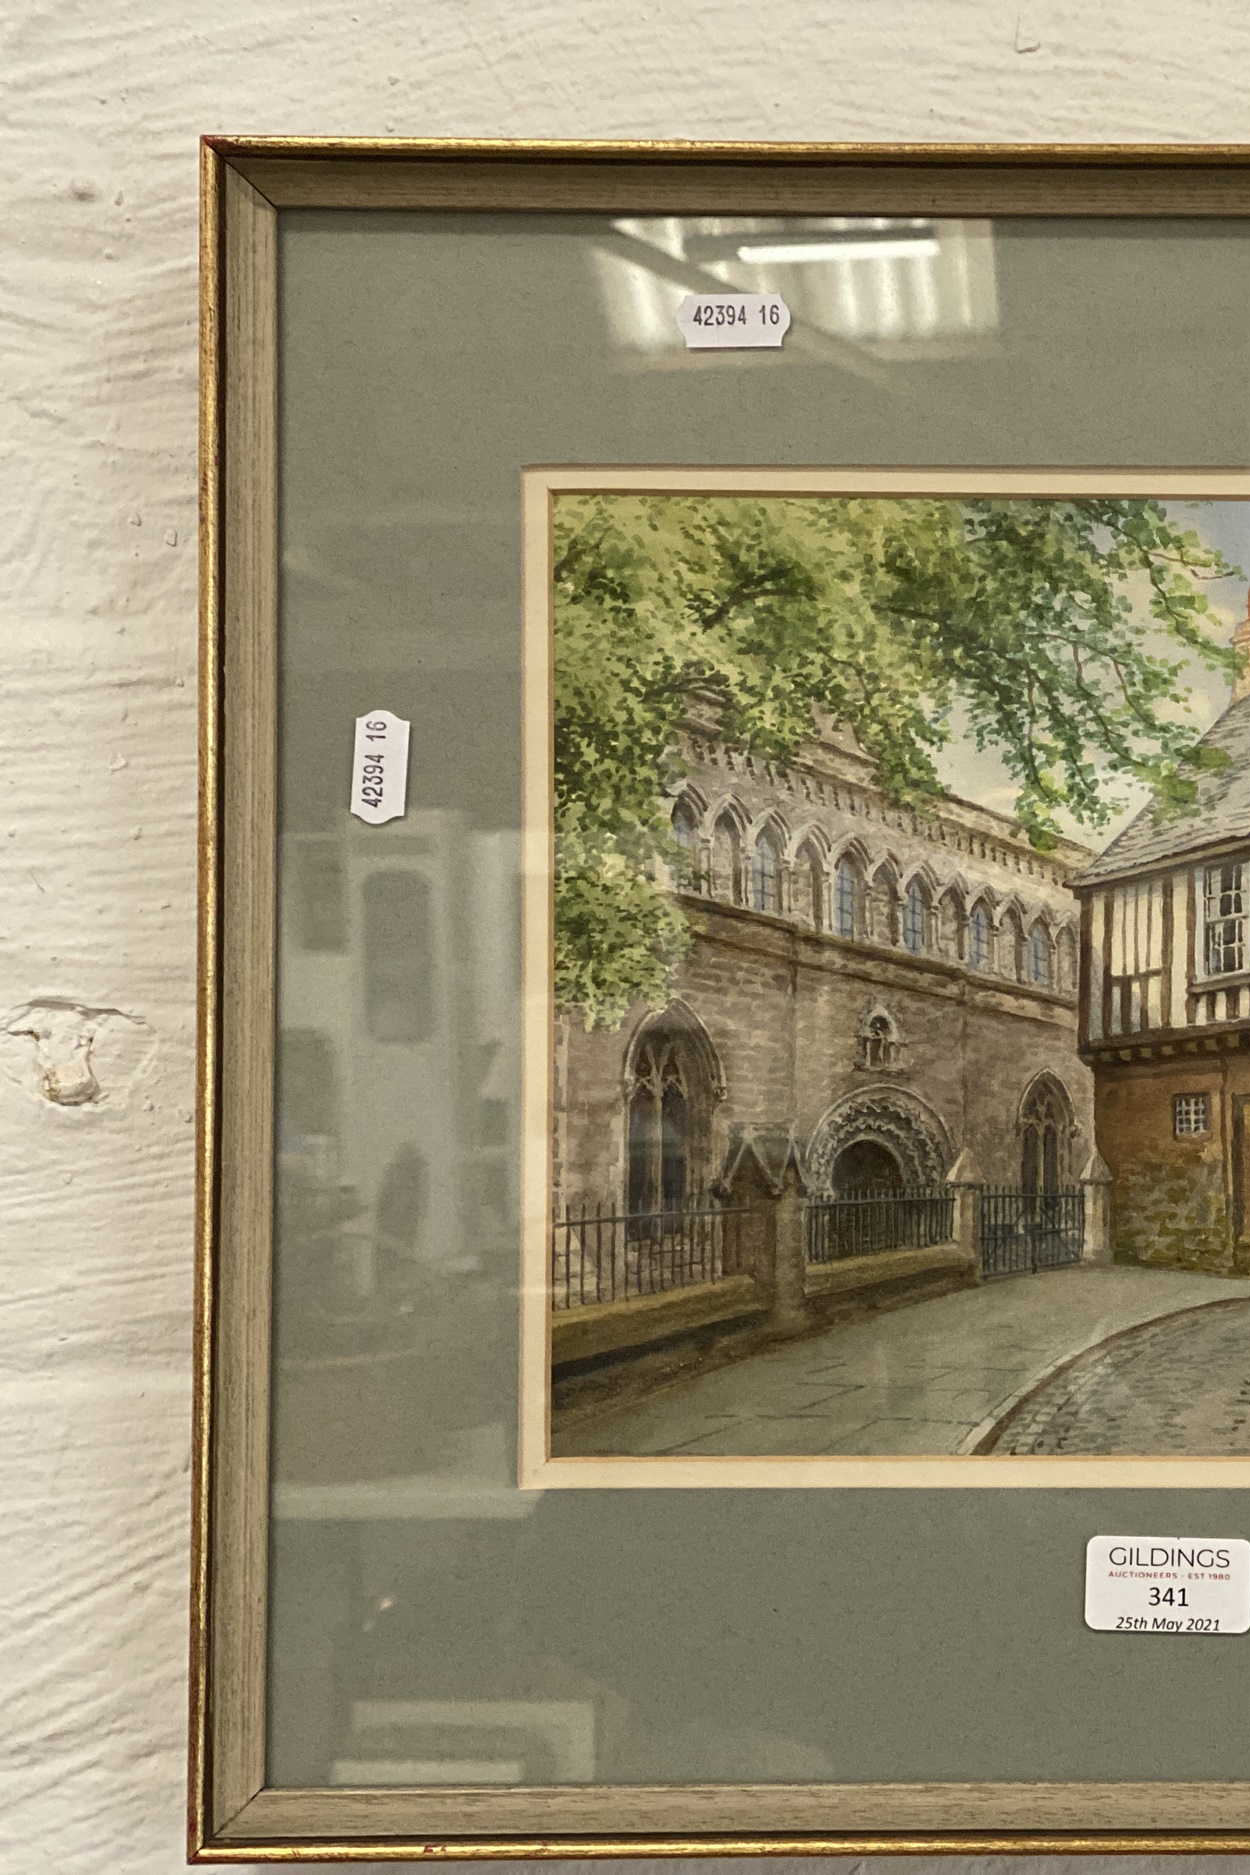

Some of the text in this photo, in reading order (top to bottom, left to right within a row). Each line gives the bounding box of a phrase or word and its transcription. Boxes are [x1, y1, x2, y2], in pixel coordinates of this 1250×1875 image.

[693, 304, 780, 326] 42394 16
[361, 721, 387, 808] 42394 16
[1109, 1547, 1231, 1568] GILDINGS
[1108, 1571, 1178, 1579] AUCTIONEERS
[1208, 1573, 1231, 1581] 1980
[1148, 1587, 1189, 1607] 341
[1115, 1617, 1220, 1632] 25th May 2021
